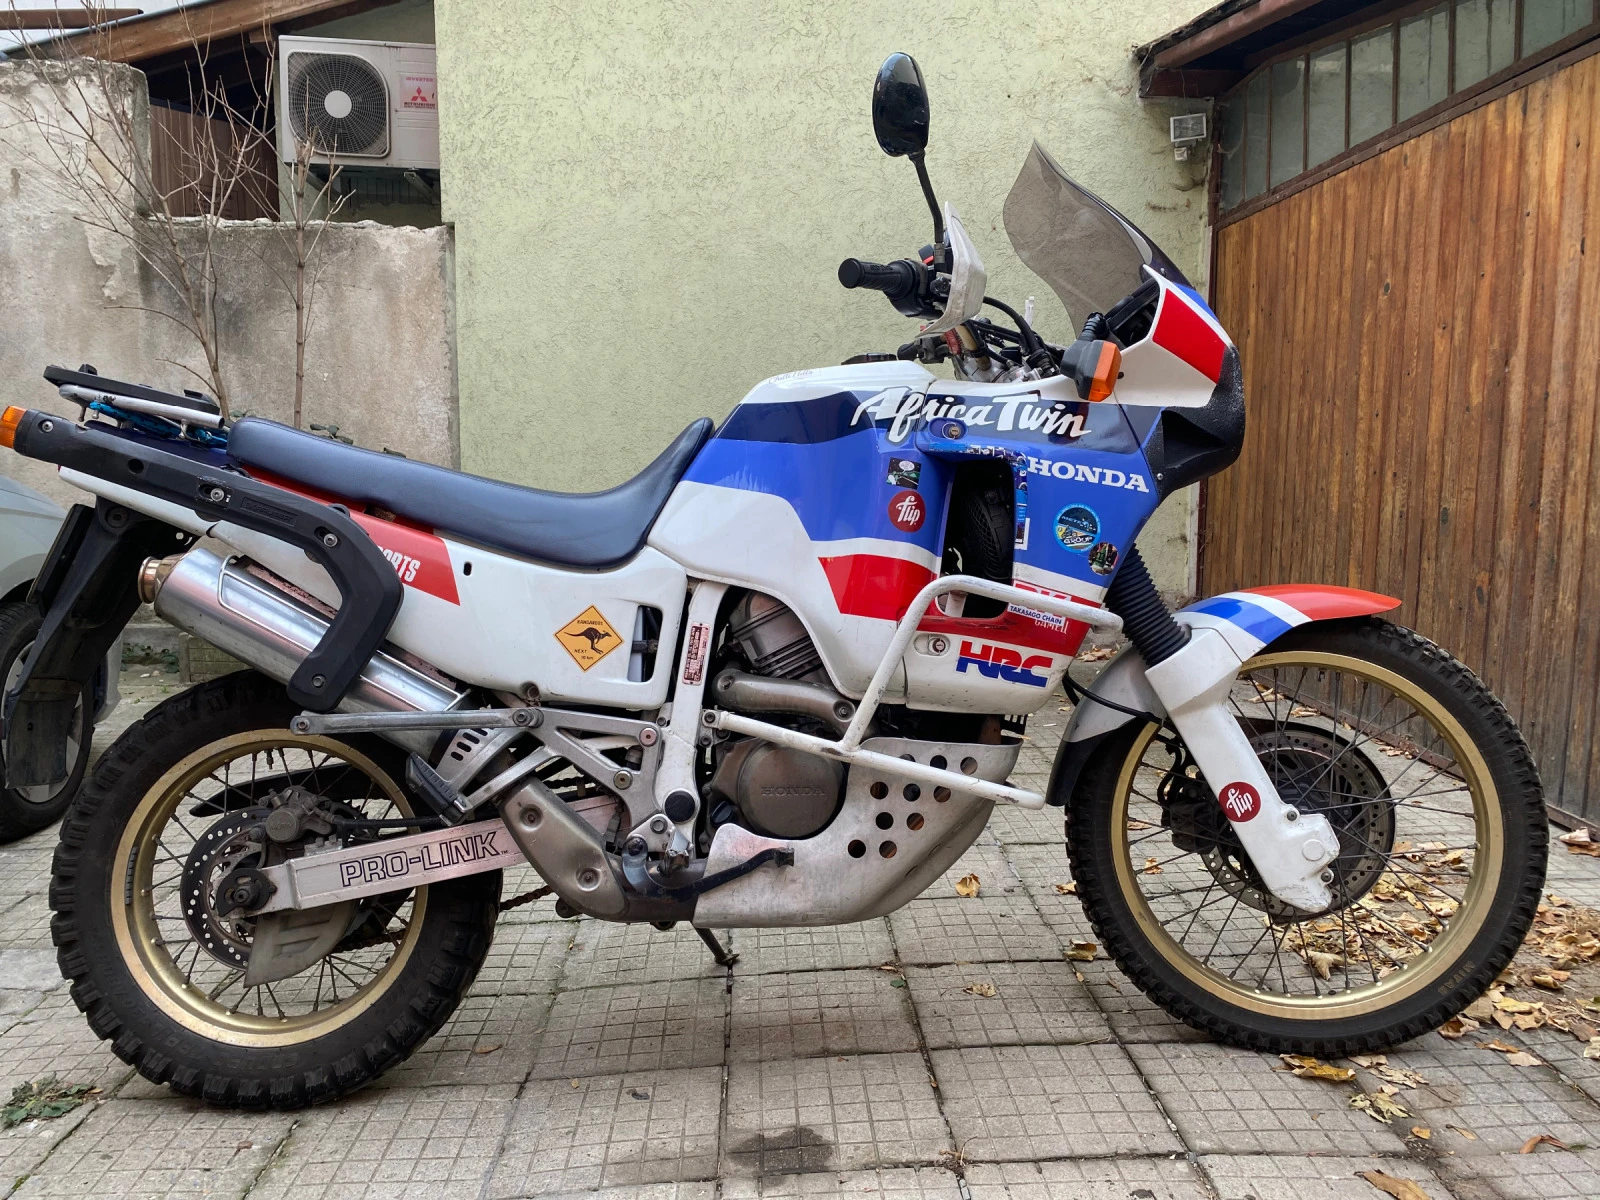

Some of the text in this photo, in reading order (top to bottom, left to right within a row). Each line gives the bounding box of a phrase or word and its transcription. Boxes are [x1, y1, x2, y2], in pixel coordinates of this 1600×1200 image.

[850, 388, 1092, 443] Africa Twin
[1027, 456, 1150, 493] HONDA
[896, 496, 920, 525] flip
[1010, 605, 1063, 625] TAKASAGO CHAIN
[955, 640, 1053, 688] HRC
[760, 786, 826, 797] HONDA
[1226, 788, 1253, 818] flip
[339, 831, 500, 887] PRO-LINK
